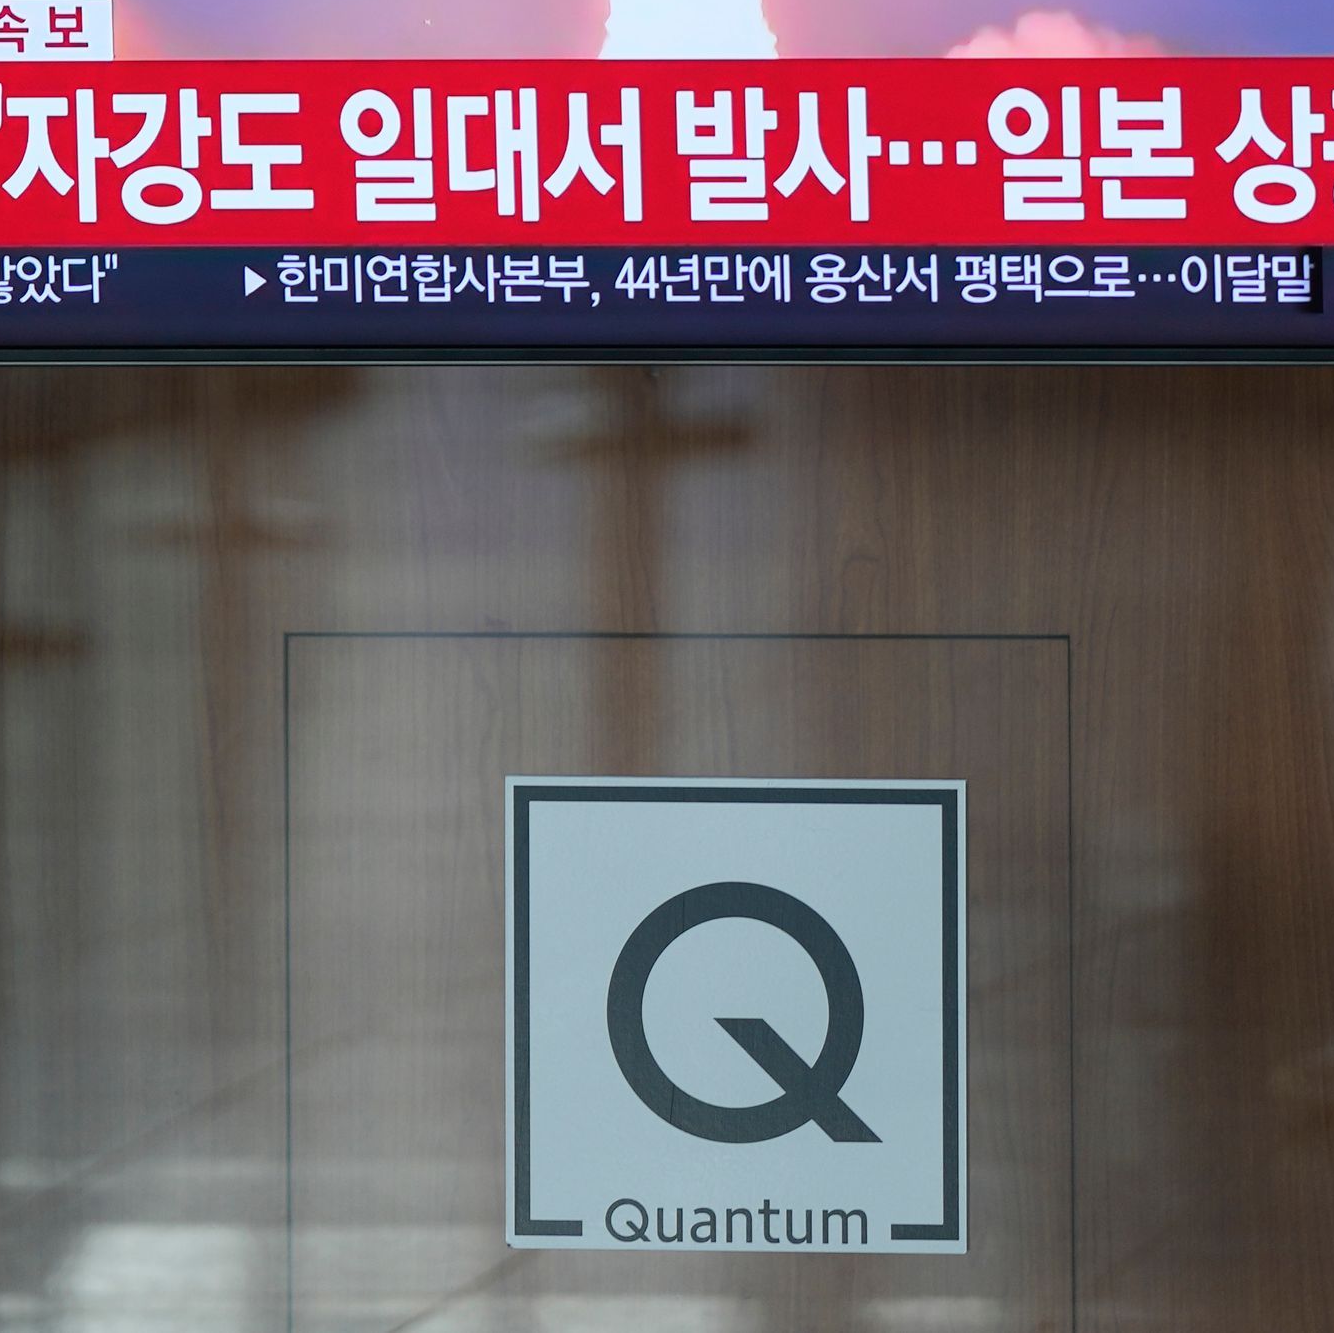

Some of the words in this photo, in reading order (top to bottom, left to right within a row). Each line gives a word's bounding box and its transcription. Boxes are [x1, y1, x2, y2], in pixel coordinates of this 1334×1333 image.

[339, 86, 643, 224] 일대서
[276, 254, 601, 308] 한미연합사본부,
[614, 254, 792, 303] 44년만에
[804, 254, 939, 303] 용산서
[607, 881, 884, 1144] Q
[604, 1198, 869, 1245] Quantum
